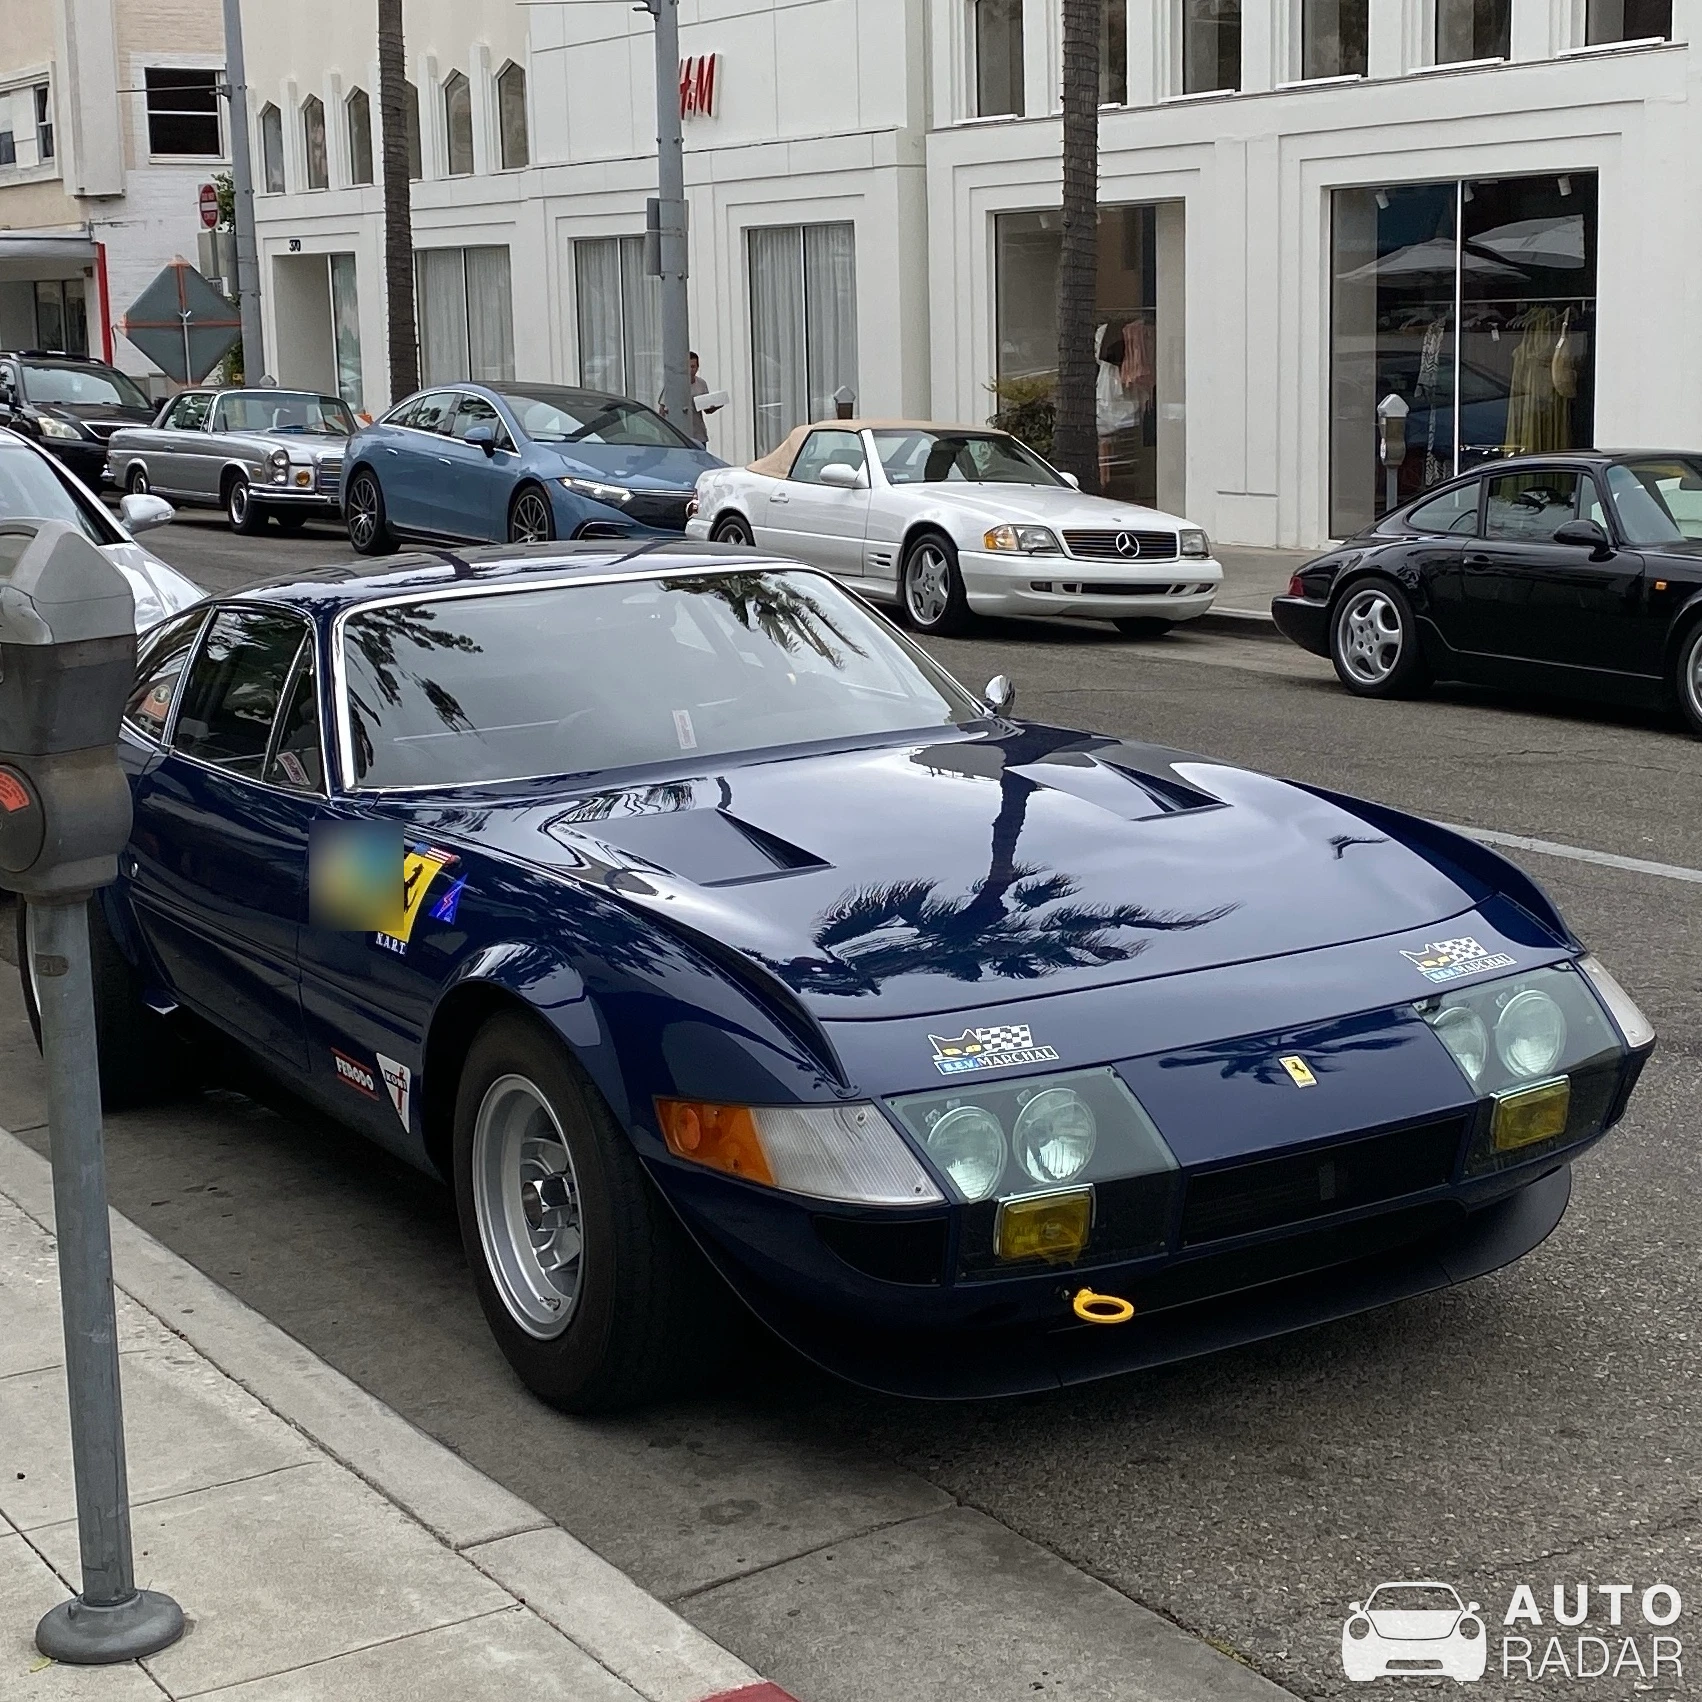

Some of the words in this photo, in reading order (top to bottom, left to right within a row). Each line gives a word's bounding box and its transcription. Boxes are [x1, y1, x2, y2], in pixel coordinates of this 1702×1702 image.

[976, 1047, 1055, 1067] MARCHAL
[335, 1056, 374, 1091] FERODO
[385, 1070, 408, 1091] KONI
